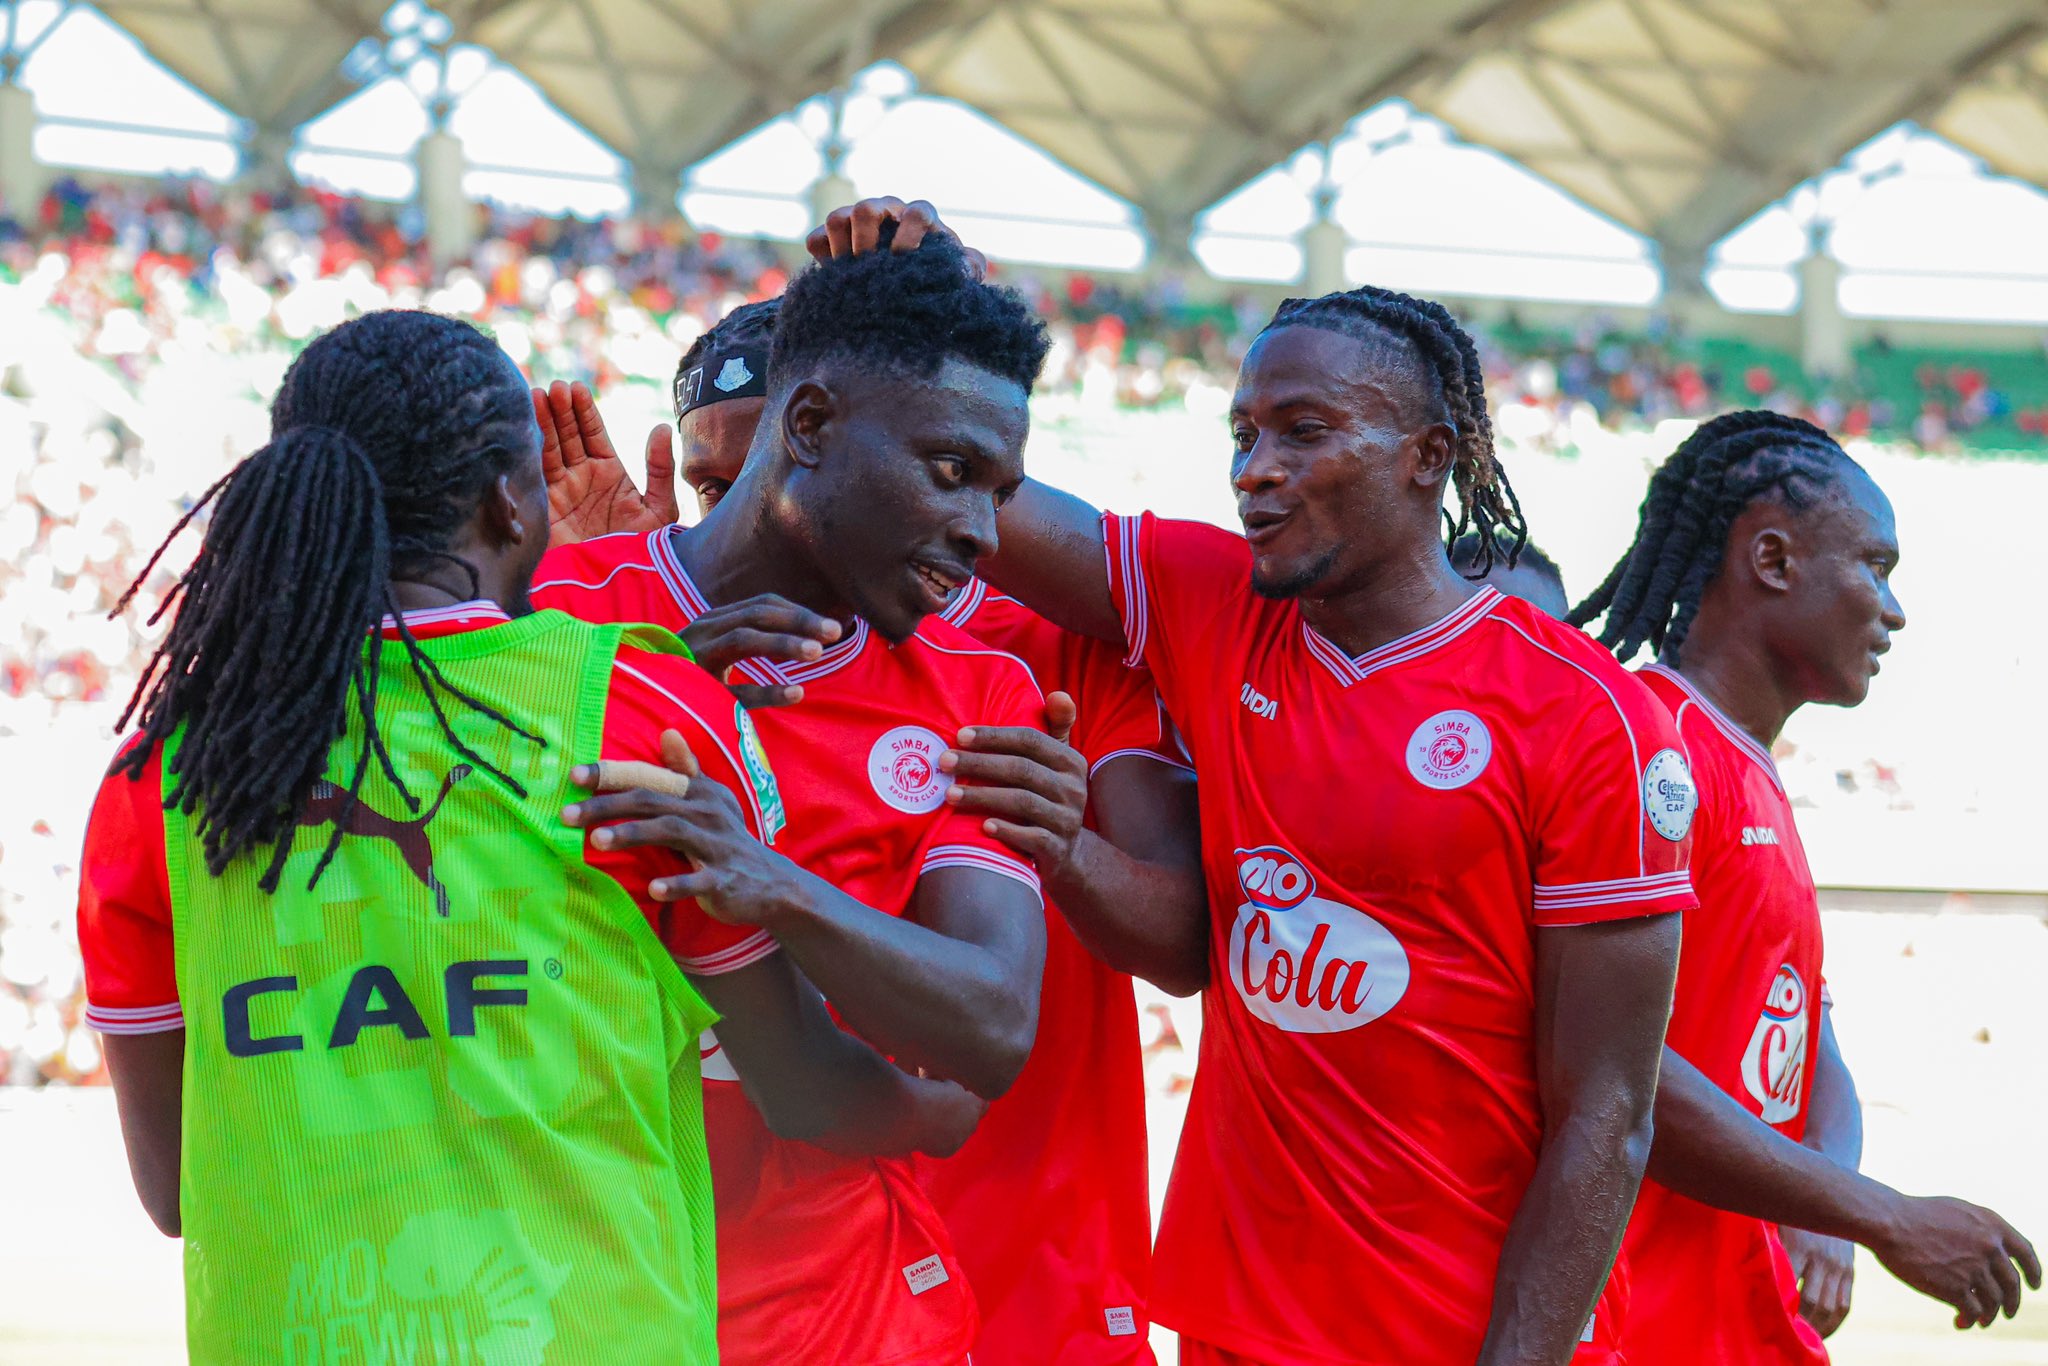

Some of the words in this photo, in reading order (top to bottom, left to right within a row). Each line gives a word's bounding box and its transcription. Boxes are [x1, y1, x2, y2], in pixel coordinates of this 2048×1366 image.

[1434, 721, 1471, 736] SIMBA
[891, 738, 930, 755] SIMBA
[1422, 763, 1448, 779] SPORTS
[1450, 763, 1471, 778] CLUB
[888, 784, 919, 803] SPORTS
[920, 784, 940, 801] CLUB
[1666, 804, 1685, 812] CAF
[1239, 856, 1308, 902] MO
[1241, 910, 1375, 1015] Cola
[222, 959, 529, 1059] CAF
[910, 1261, 938, 1278] SANDA
[283, 1238, 379, 1325] MO
[1110, 1312, 1130, 1320] SANDA
